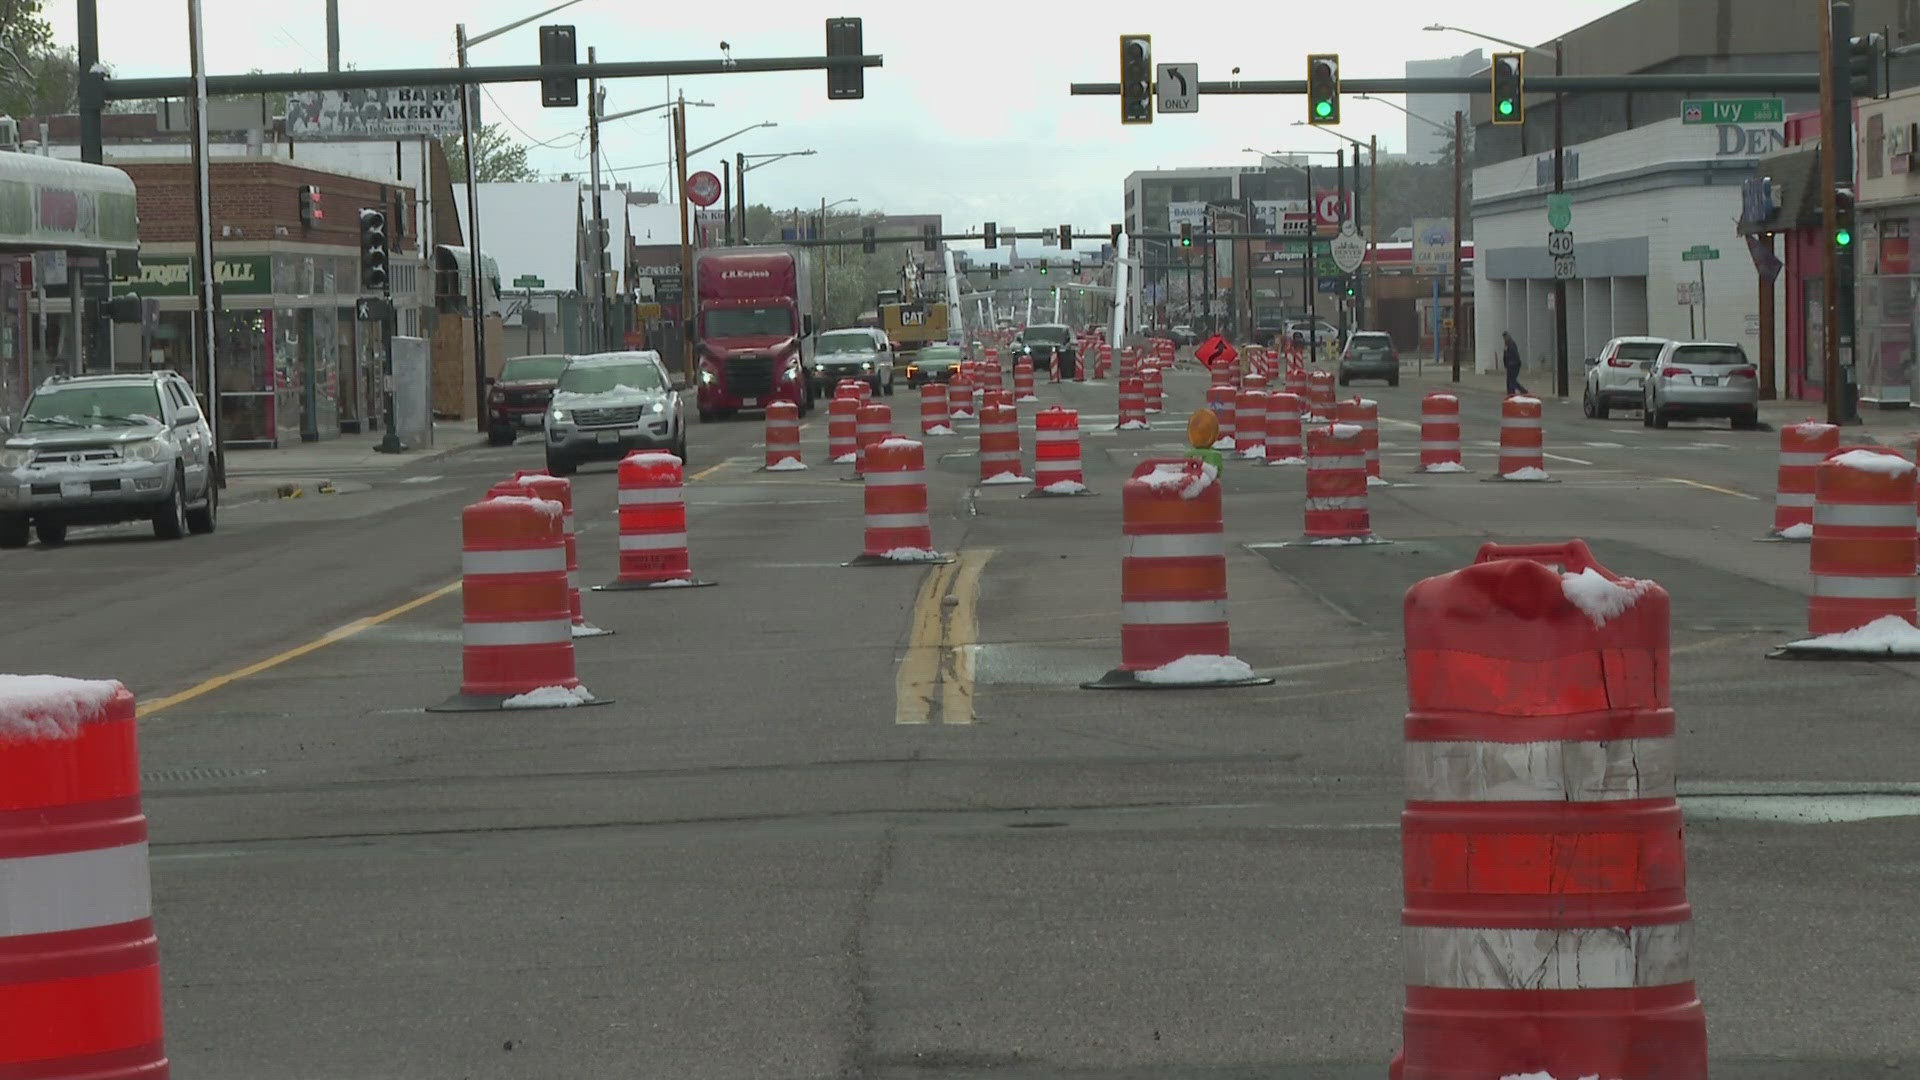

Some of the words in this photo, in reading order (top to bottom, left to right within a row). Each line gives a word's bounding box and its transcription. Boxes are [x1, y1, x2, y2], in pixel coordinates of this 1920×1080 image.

[1165, 98, 1190, 110] ONLY
[1713, 102, 1743, 122] Ivy
[1552, 236, 1571, 251] 40
[1556, 261, 1575, 277] 287
[902, 311, 924, 326] CAT
